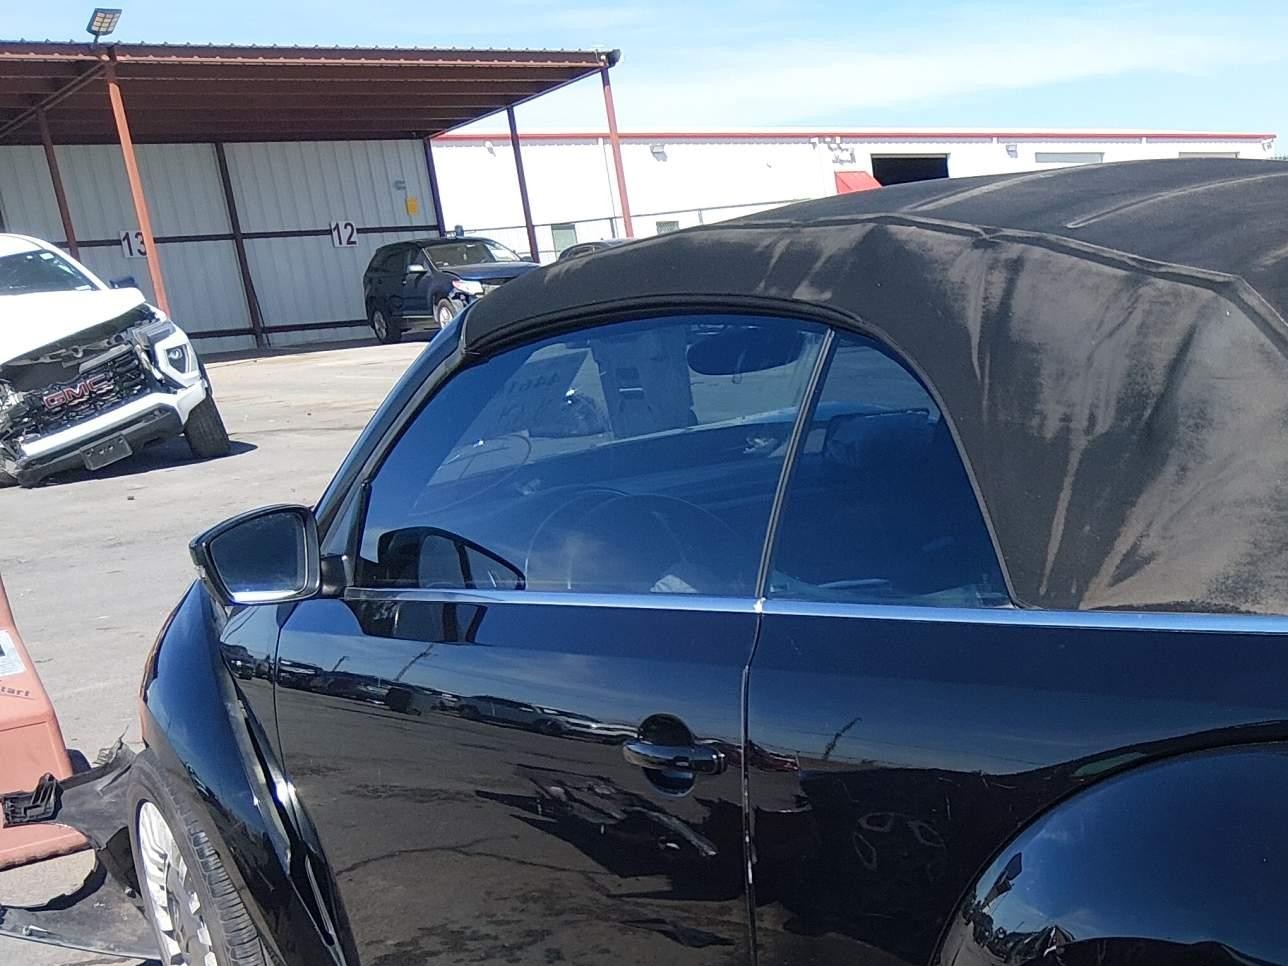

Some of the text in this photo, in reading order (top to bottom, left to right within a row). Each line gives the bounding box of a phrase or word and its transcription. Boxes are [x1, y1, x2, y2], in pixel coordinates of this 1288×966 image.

[122, 231, 147, 257] 13
[332, 222, 357, 246] 12
[43, 372, 112, 410] GMC
